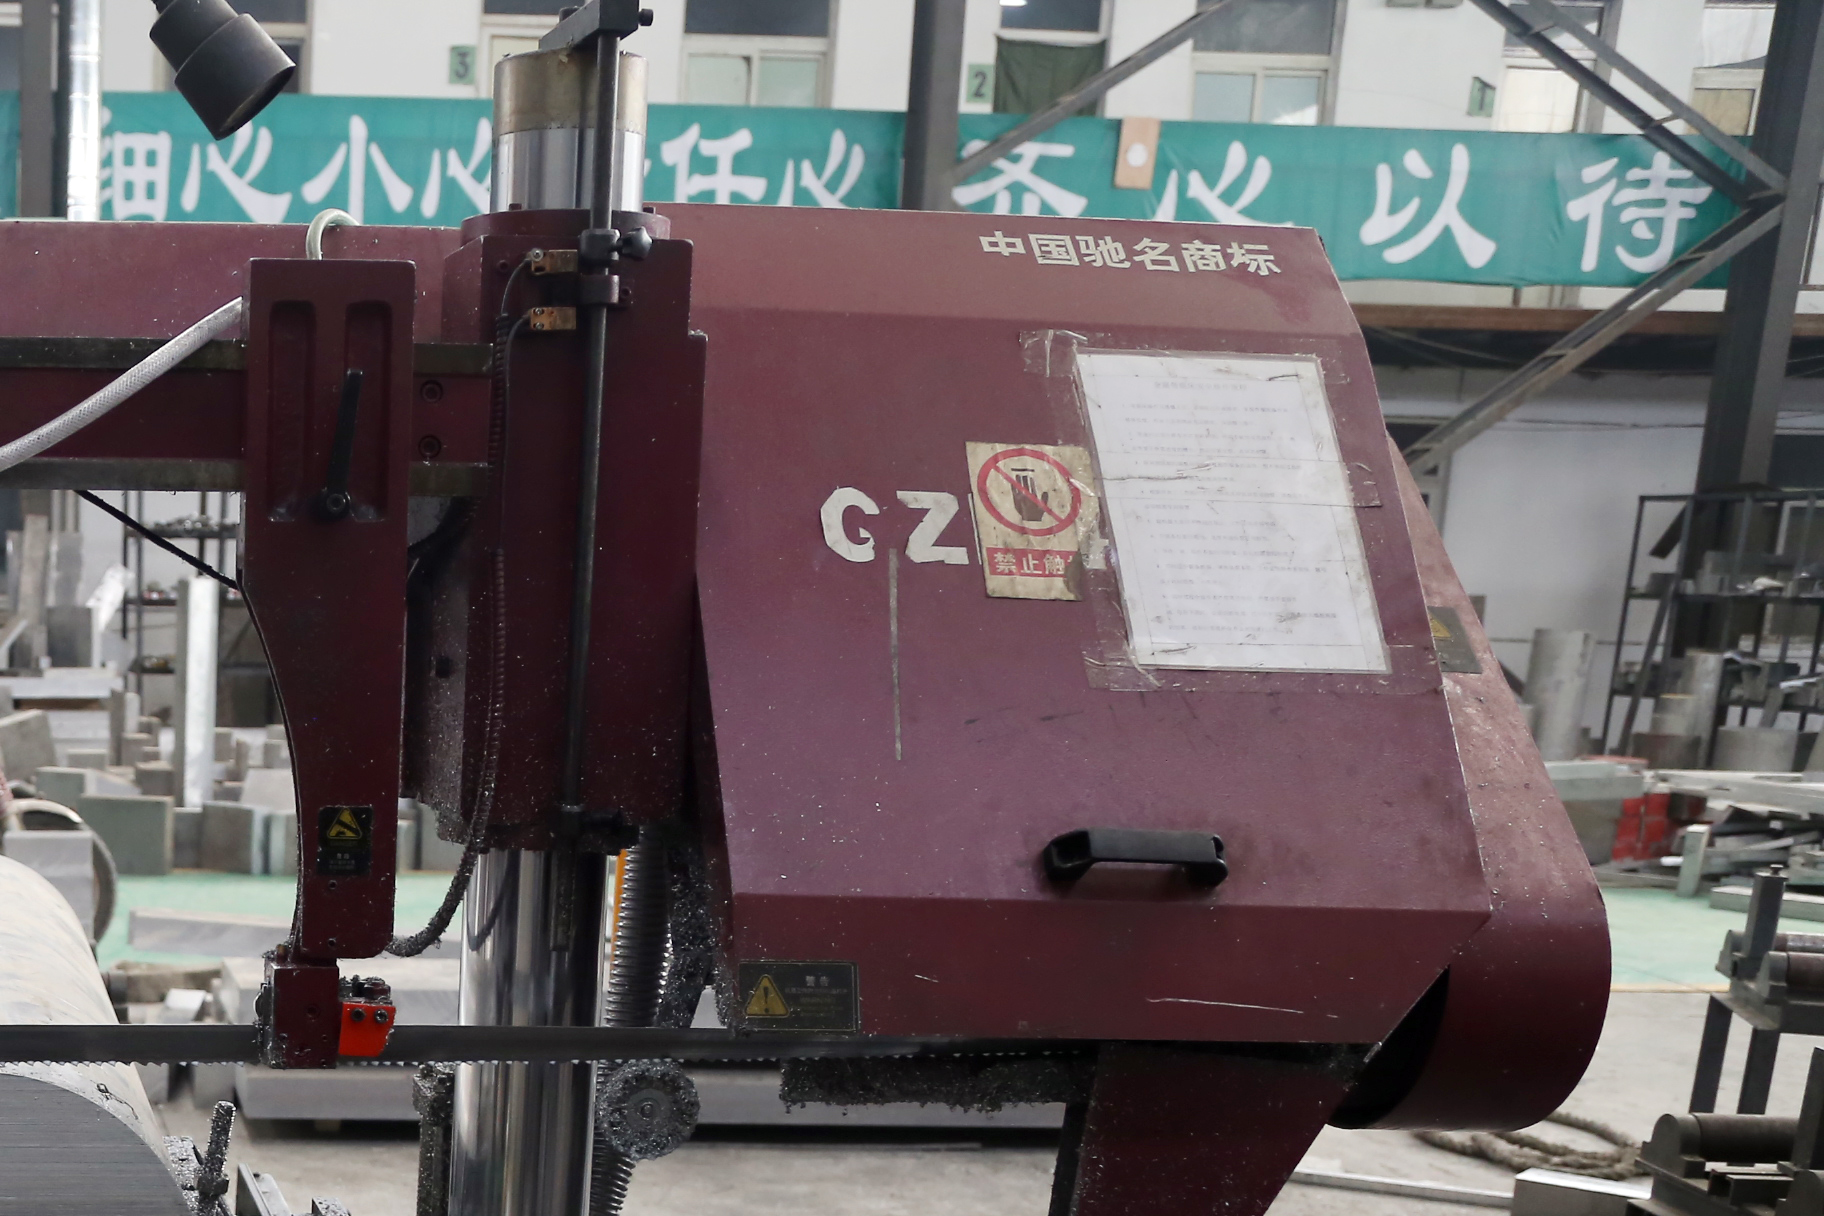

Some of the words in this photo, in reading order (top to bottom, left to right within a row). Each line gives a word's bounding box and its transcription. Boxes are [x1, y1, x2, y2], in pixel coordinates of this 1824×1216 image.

[455, 51, 470, 80] 3
[973, 71, 987, 99] 2
[100, 107, 865, 222] 细心小心任心
[979, 231, 1282, 276] 中国驰名商标
[820, 486, 982, 565] GZ
[993, 551, 1075, 576] 禁止触
